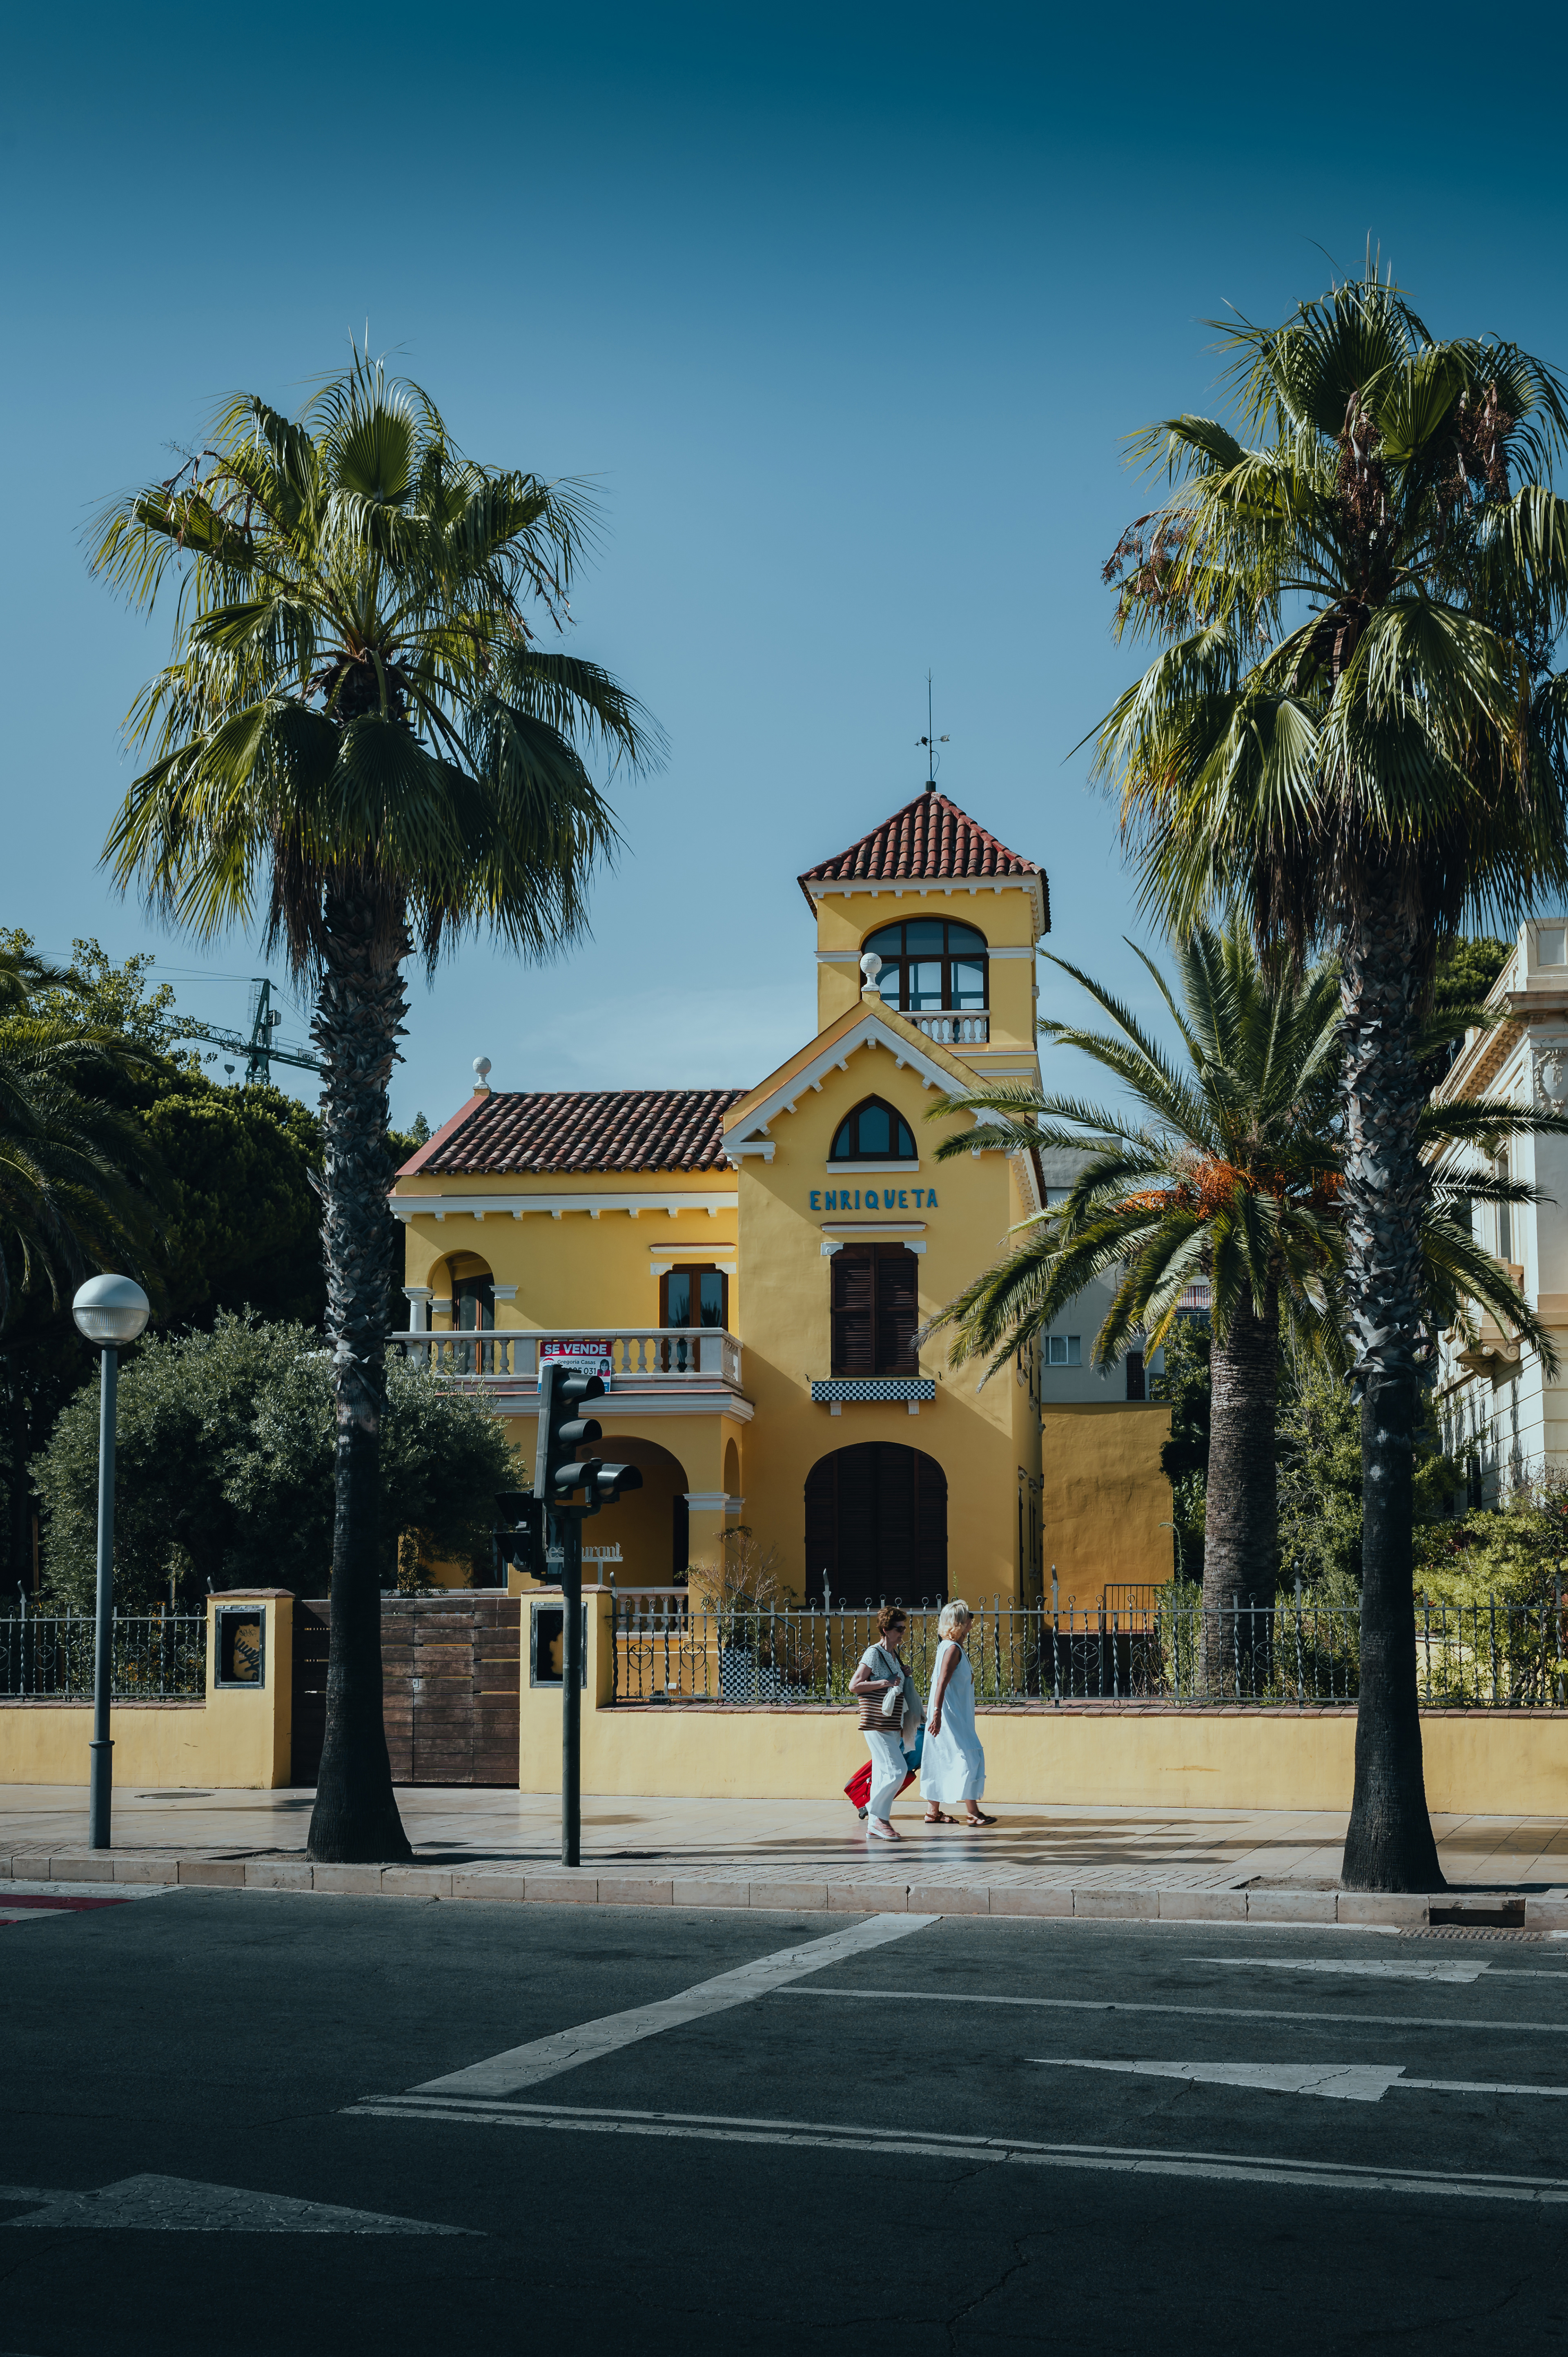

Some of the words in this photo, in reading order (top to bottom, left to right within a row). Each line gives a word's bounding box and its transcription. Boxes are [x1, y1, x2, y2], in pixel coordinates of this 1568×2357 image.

[810, 1189, 938, 1210] ENRIQUETA
[544, 1344, 560, 1355] SE
[563, 1344, 607, 1354] VENDE
